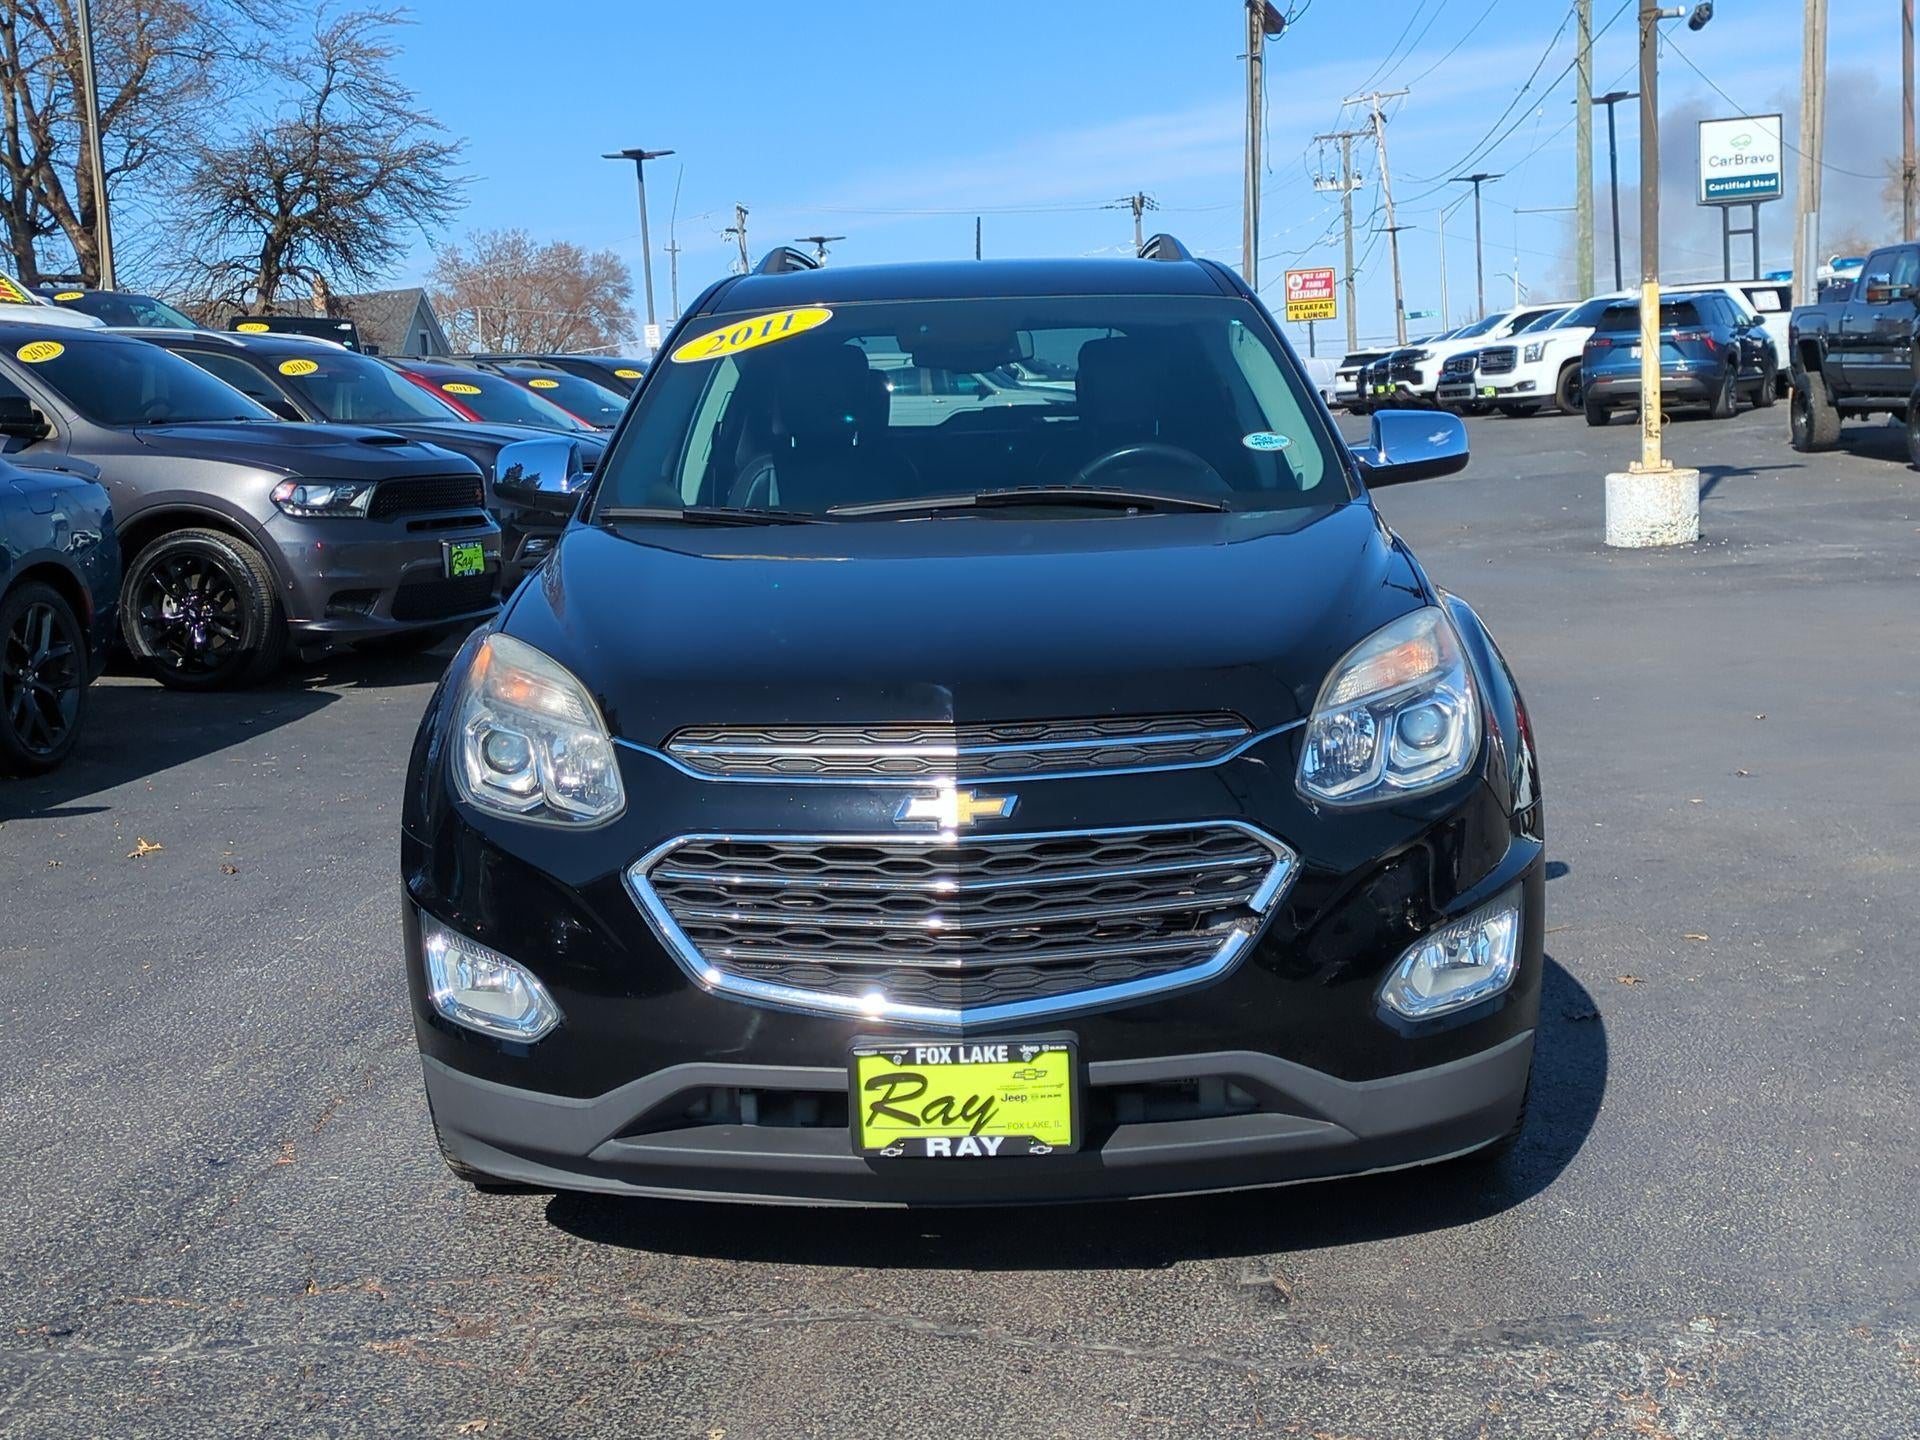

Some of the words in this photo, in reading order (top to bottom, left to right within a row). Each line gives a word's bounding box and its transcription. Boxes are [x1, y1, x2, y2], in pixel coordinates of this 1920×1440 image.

[1708, 153, 1775, 168] CarBravo
[1708, 180, 1751, 191] Certified
[1752, 178, 1776, 188] Used
[1290, 288, 1331, 300] RESTAURANT
[1288, 303, 1333, 312] BREAKFAST
[1303, 311, 1329, 319] LUNCH
[703, 313, 797, 355] 2011
[23, 342, 57, 360] 2020
[285, 361, 312, 373] 2018
[453, 551, 474, 569] Ray
[915, 1047, 953, 1065] FOX
[958, 1045, 1009, 1064] LAKE
[864, 1071, 1000, 1137] Ray
[1000, 1092, 1028, 1103] Jeep
[1007, 1121, 1025, 1130] FOX
[1026, 1119, 1052, 1129] LAKE,
[925, 1136, 1006, 1158] RAY
